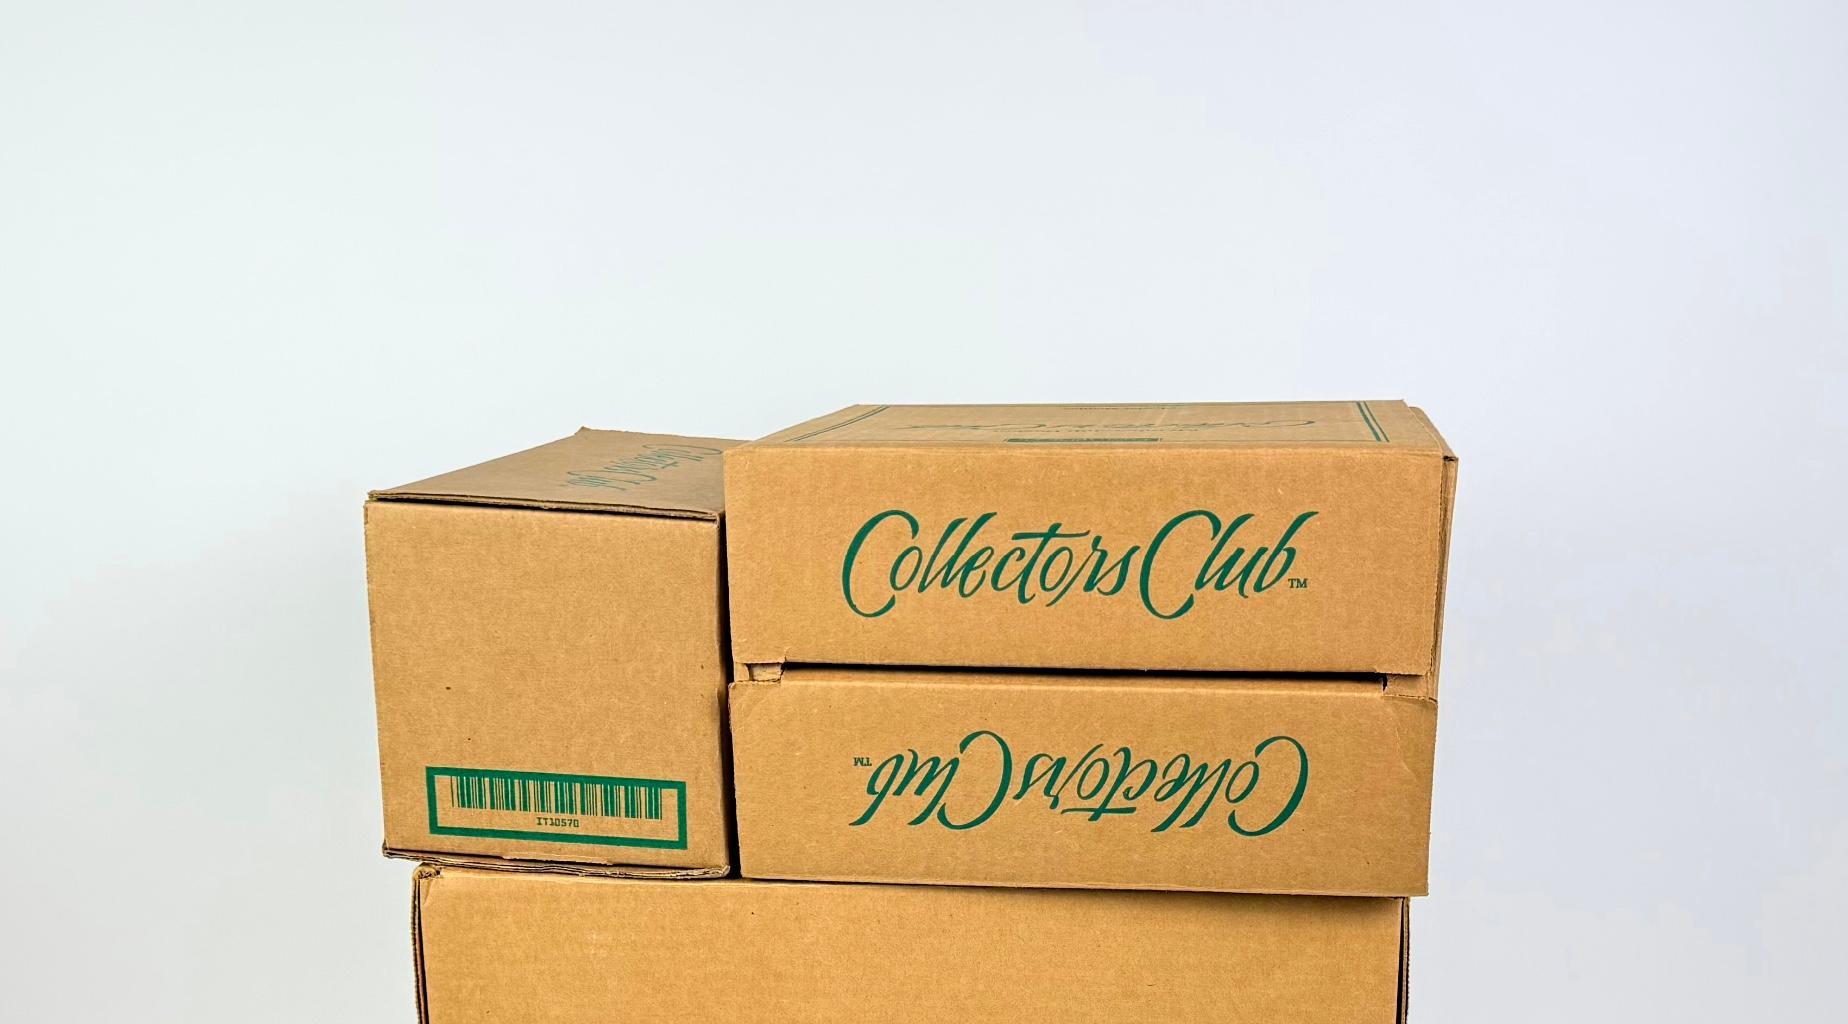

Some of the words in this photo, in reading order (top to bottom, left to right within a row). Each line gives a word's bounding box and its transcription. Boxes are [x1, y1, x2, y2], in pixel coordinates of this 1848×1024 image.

[842, 509, 1140, 617] Collectors
[1139, 509, 1319, 620] Club
[535, 815, 580, 828] IT10570
[1012, 735, 1309, 837] Collectors
